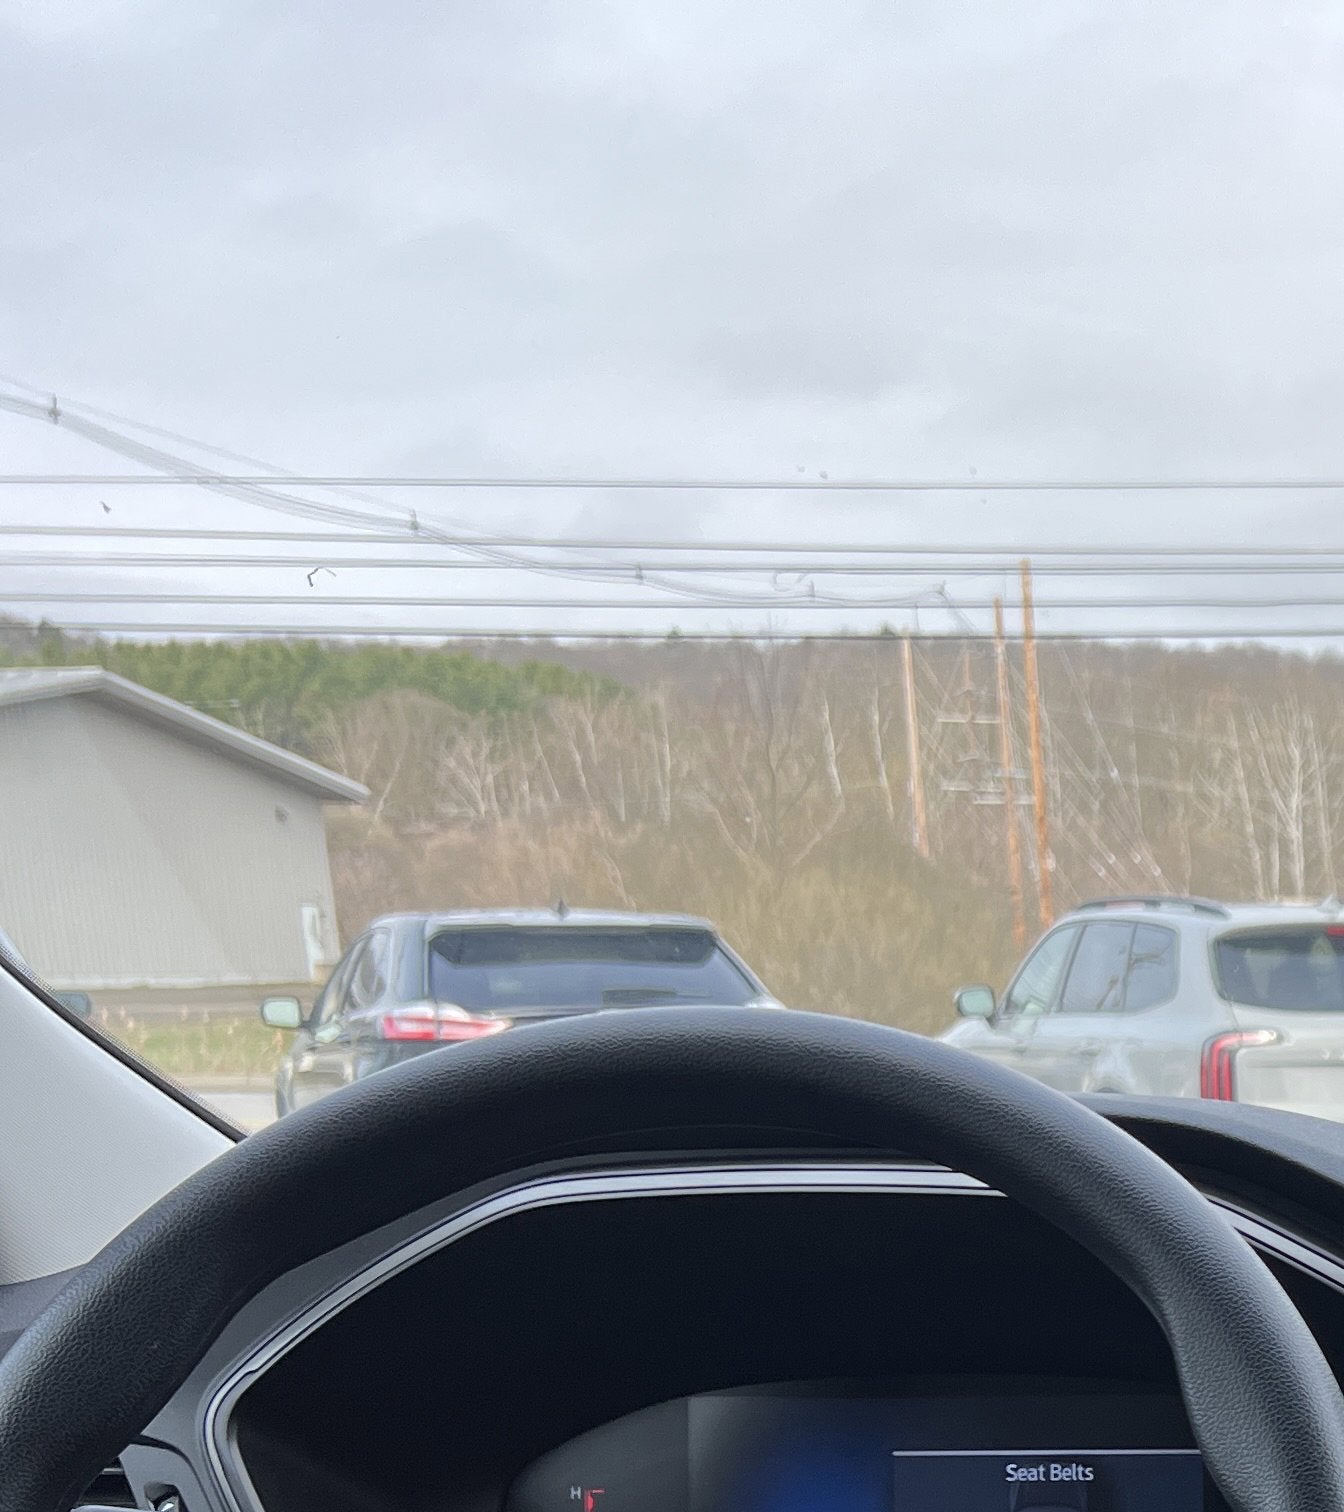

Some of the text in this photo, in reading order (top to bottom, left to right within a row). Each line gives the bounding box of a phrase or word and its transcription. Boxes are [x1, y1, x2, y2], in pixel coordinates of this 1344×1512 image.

[1005, 1462, 1094, 1482] Seat Belts
[570, 1486, 582, 1500] H
